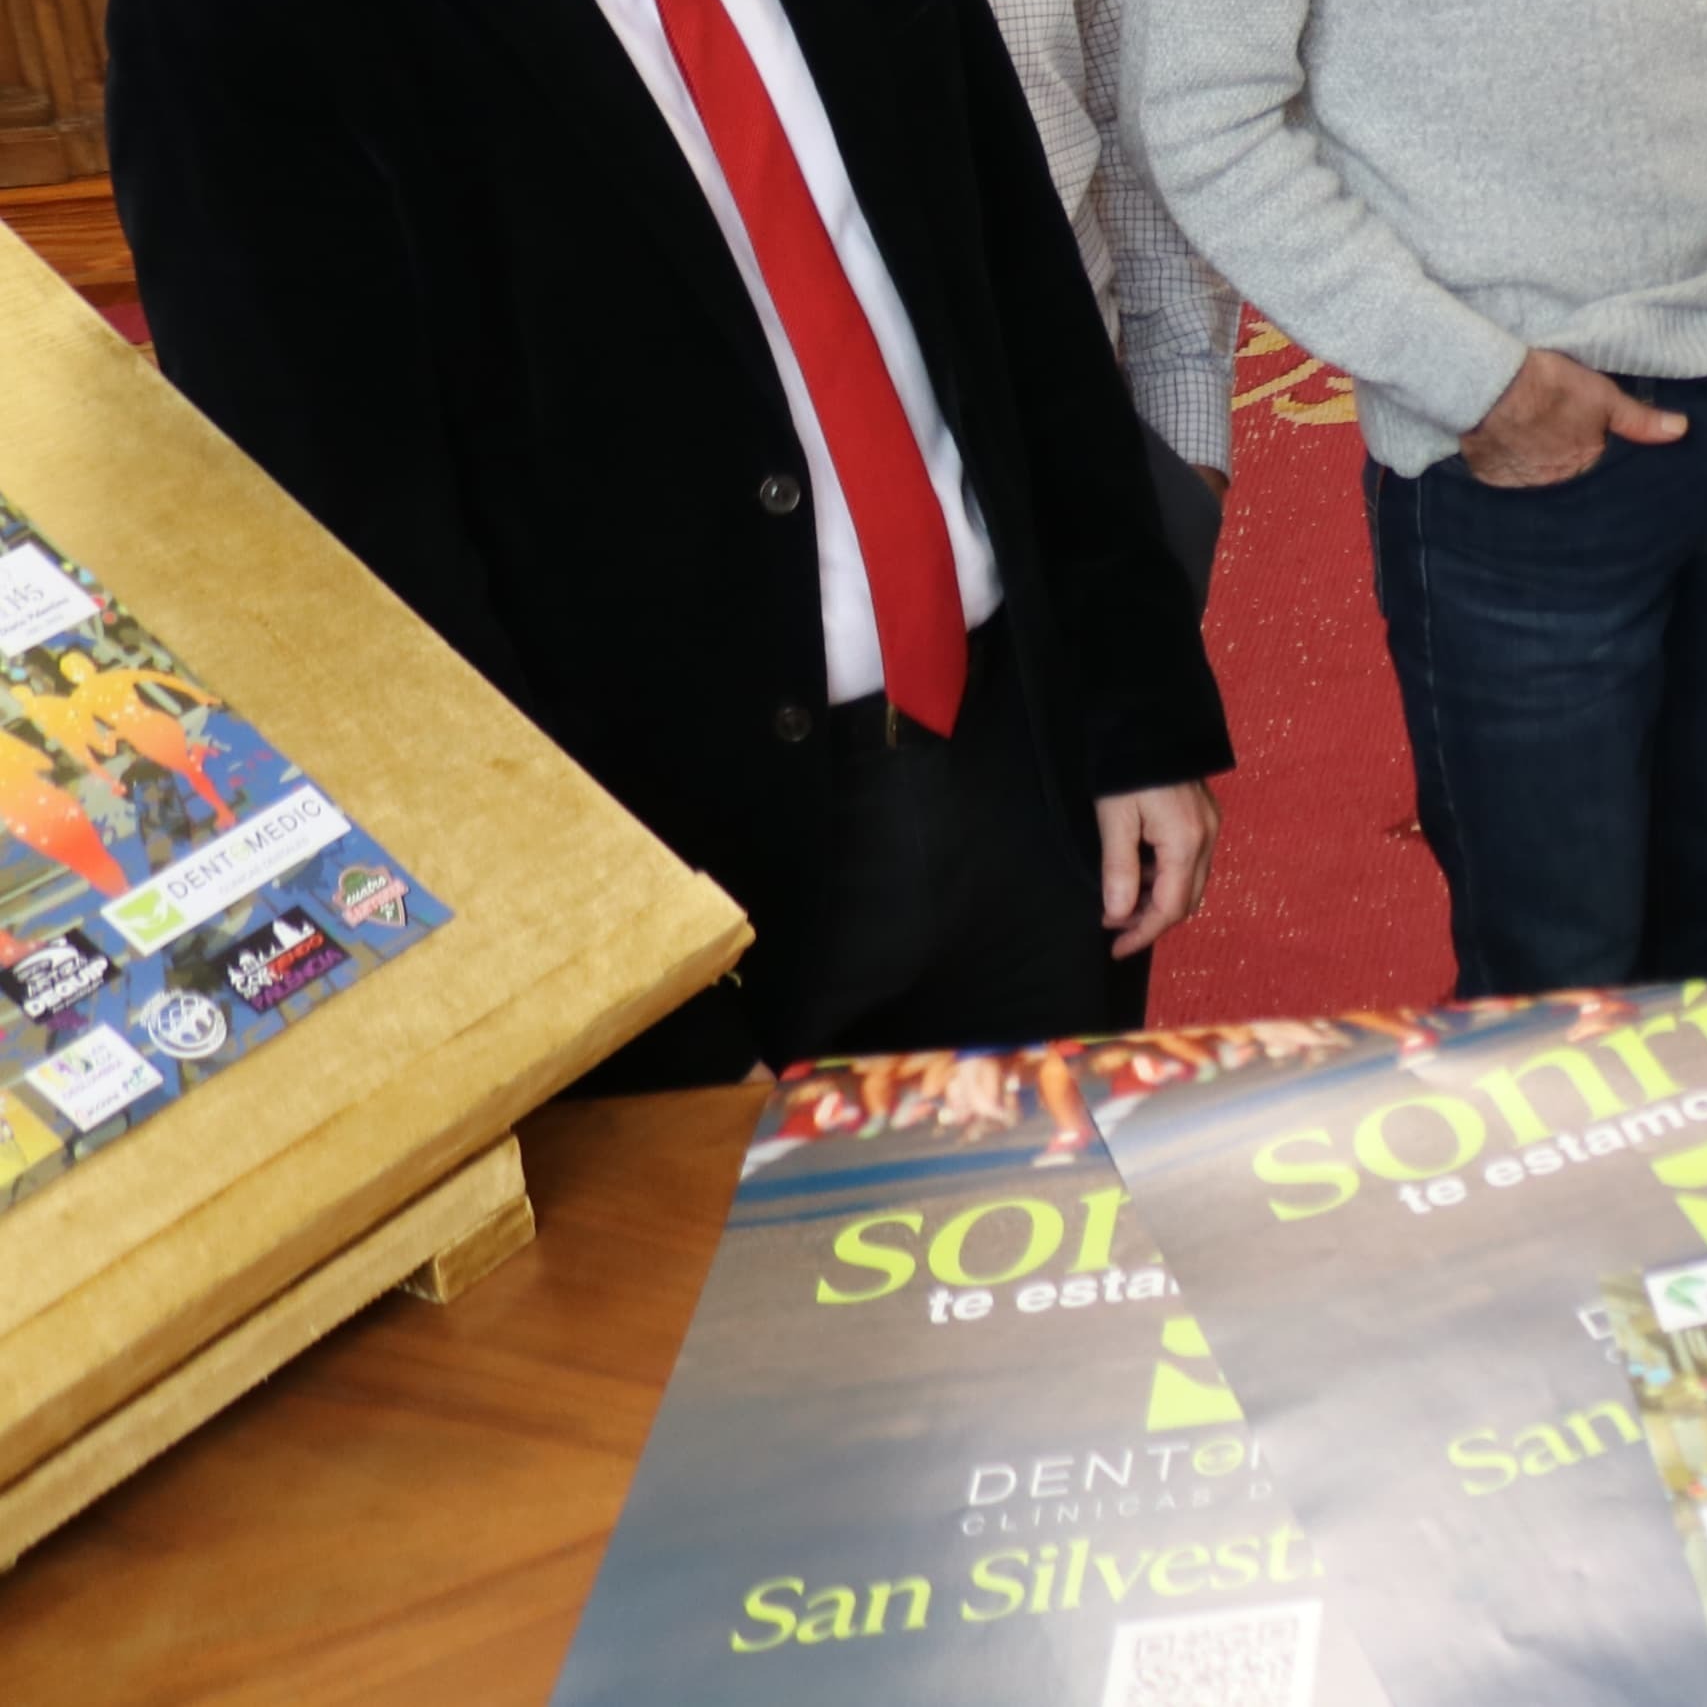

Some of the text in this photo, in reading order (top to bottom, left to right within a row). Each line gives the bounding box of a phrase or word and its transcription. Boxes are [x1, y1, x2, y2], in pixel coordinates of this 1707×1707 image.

[1399, 1175, 1467, 1218] te
[930, 1268, 1180, 1324] te esta
[731, 1520, 1325, 1654] San Silvest
